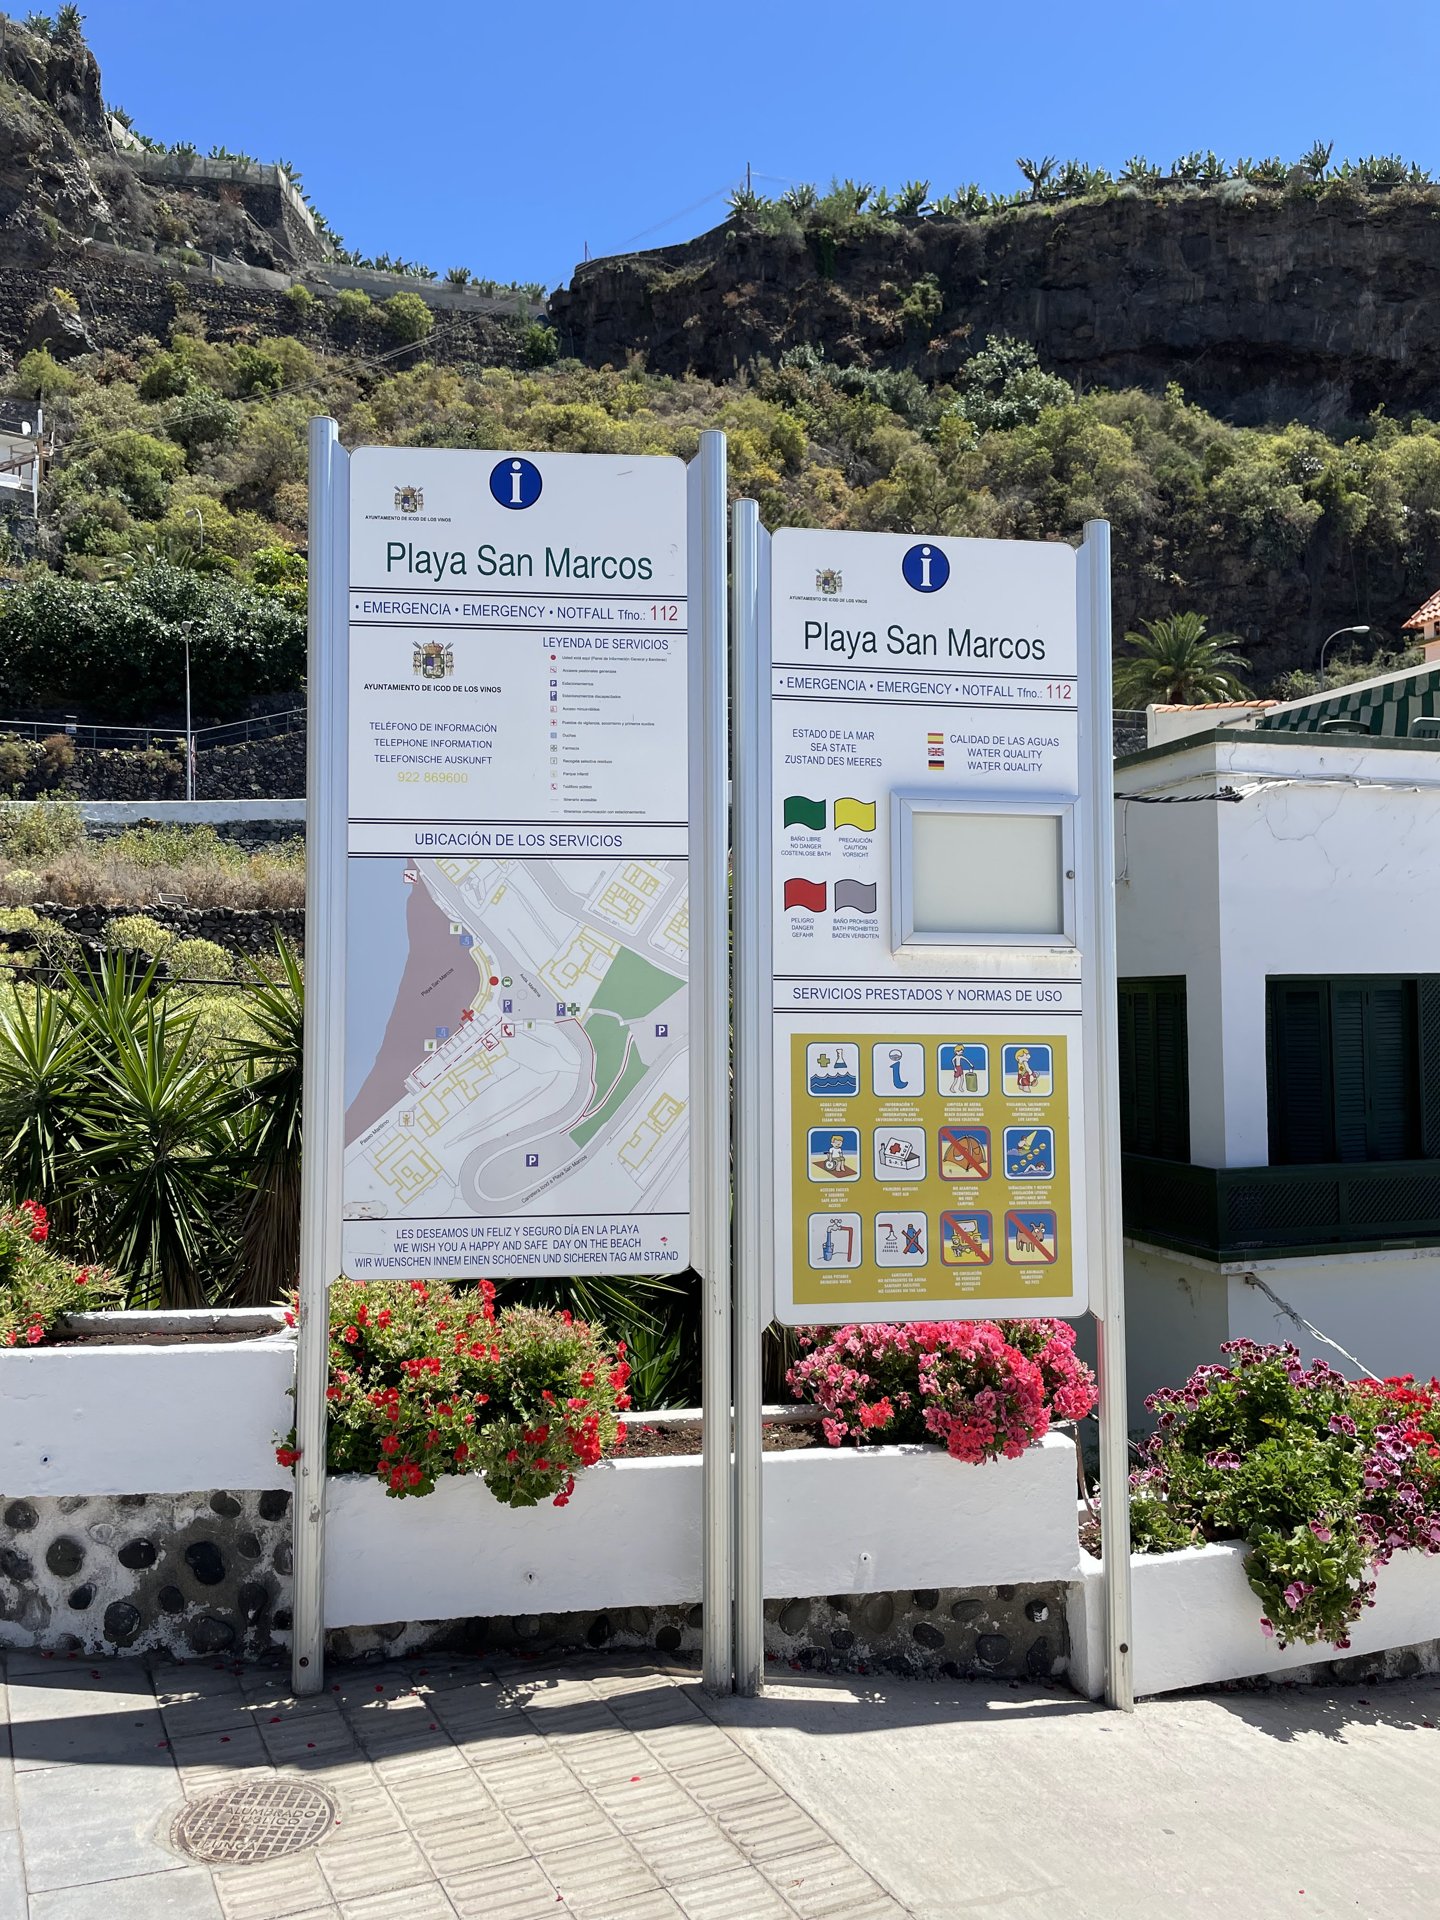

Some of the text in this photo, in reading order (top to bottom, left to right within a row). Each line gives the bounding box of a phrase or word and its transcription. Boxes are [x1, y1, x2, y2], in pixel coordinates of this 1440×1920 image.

[386, 542, 653, 582] Playa San Marcos
[363, 601, 678, 621] EMERGENCIA EMERGENCY NOTFALL Tfno.: 112
[543, 637, 669, 650] LEYENDA DE SERVICIOS
[805, 620, 1046, 660] Playa San Marcos
[364, 683, 420, 691] AYUNTAMIENTO
[453, 685, 462, 693] DE
[480, 686, 501, 694] VINOS
[787, 677, 1071, 700] EMERGENCIA EMERGENCY NOTFALL Tfno.: 112
[370, 721, 497, 733] TELÉFONO DE INFORMACIÓN
[792, 728, 875, 740] ESTADO DE LA MAR
[950, 734, 1059, 746] CALIDAD DE LAS AGUAS
[374, 739, 492, 748] TELEPHONE INFORMATION
[810, 743, 857, 753] SEA STATE
[374, 754, 492, 765] TELEFONISCHE AUSKUNFT
[967, 748, 1042, 759] WATER QUALITY
[785, 755, 882, 767] ZUSTAND DES MEERES
[967, 761, 1042, 771] WATER QUALITY
[397, 772, 419, 782] 922
[415, 831, 622, 847] UBICACIÓN DE LOS SERVICIOS
[793, 987, 1062, 1002] SERVICIOS PRESTADOS Y NORMAS DE USO
[396, 1224, 639, 1239] LES DESEAMOS UN FELIZ Y SEGURO DÍA EN LA PLAYA
[394, 1238, 641, 1253] WE WISH YOU A HAPPY AND SAFE DAY ON THE BEACH
[355, 1251, 678, 1267] WIR WUENSCHEN INNEM EINEN SCHOENEN UND SICHEREN TAG AM STRAND
[225, 1807, 316, 1819] ALUMBRADO
